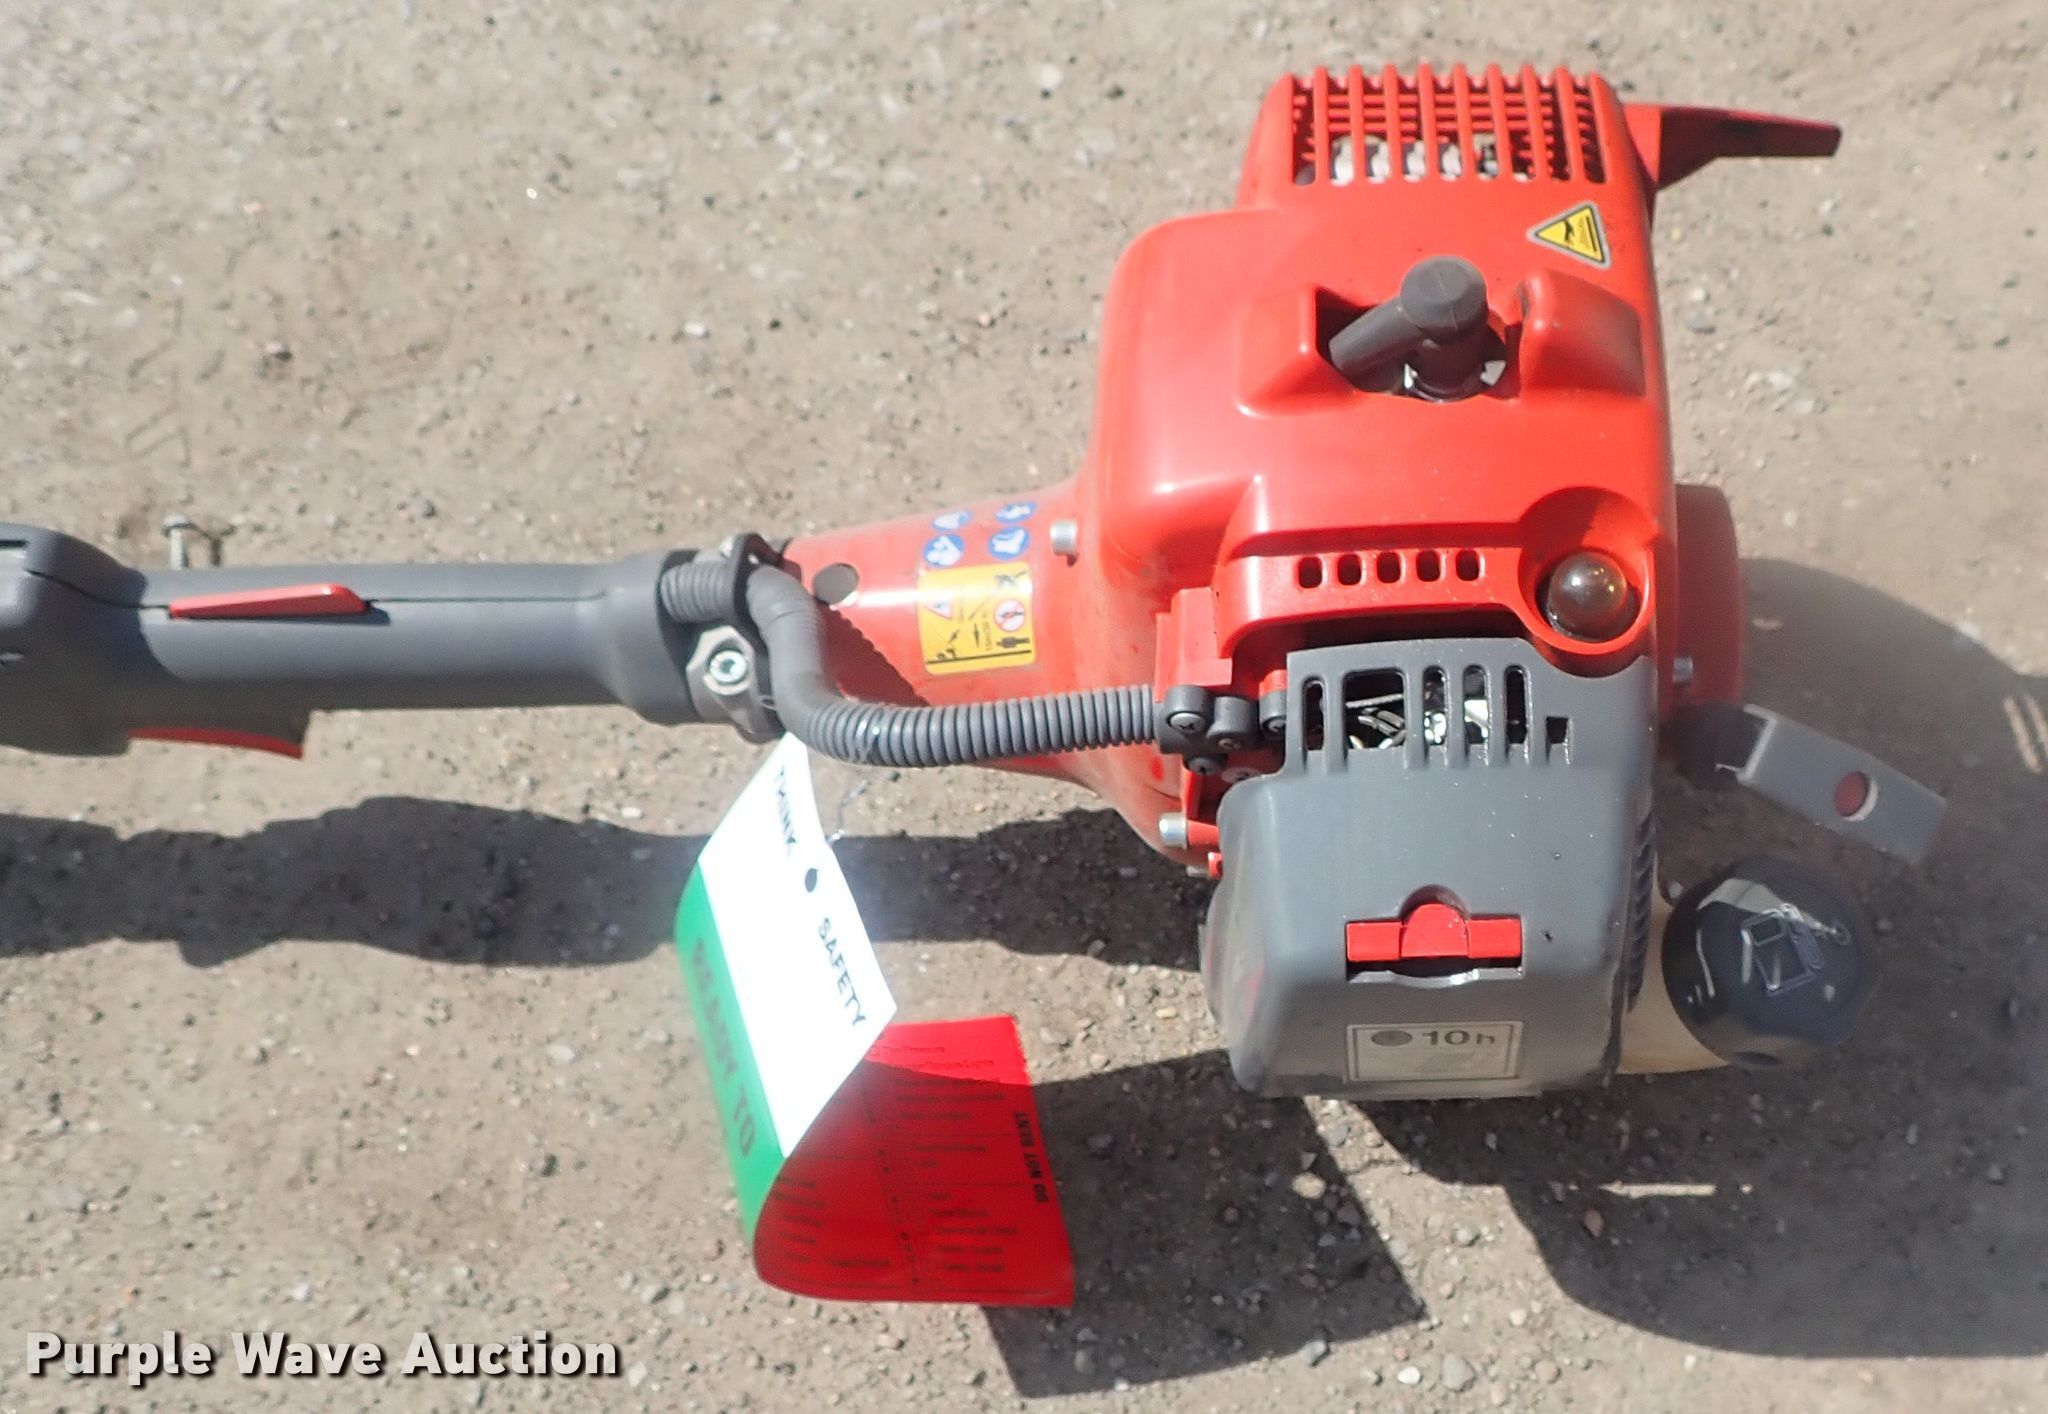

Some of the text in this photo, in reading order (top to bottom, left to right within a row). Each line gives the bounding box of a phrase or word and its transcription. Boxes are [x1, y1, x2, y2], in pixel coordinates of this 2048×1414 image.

[818, 917, 866, 1026] SAFETY
[734, 1083, 755, 1157] TO
[1014, 1112, 1048, 1203] DO NOT RENT
